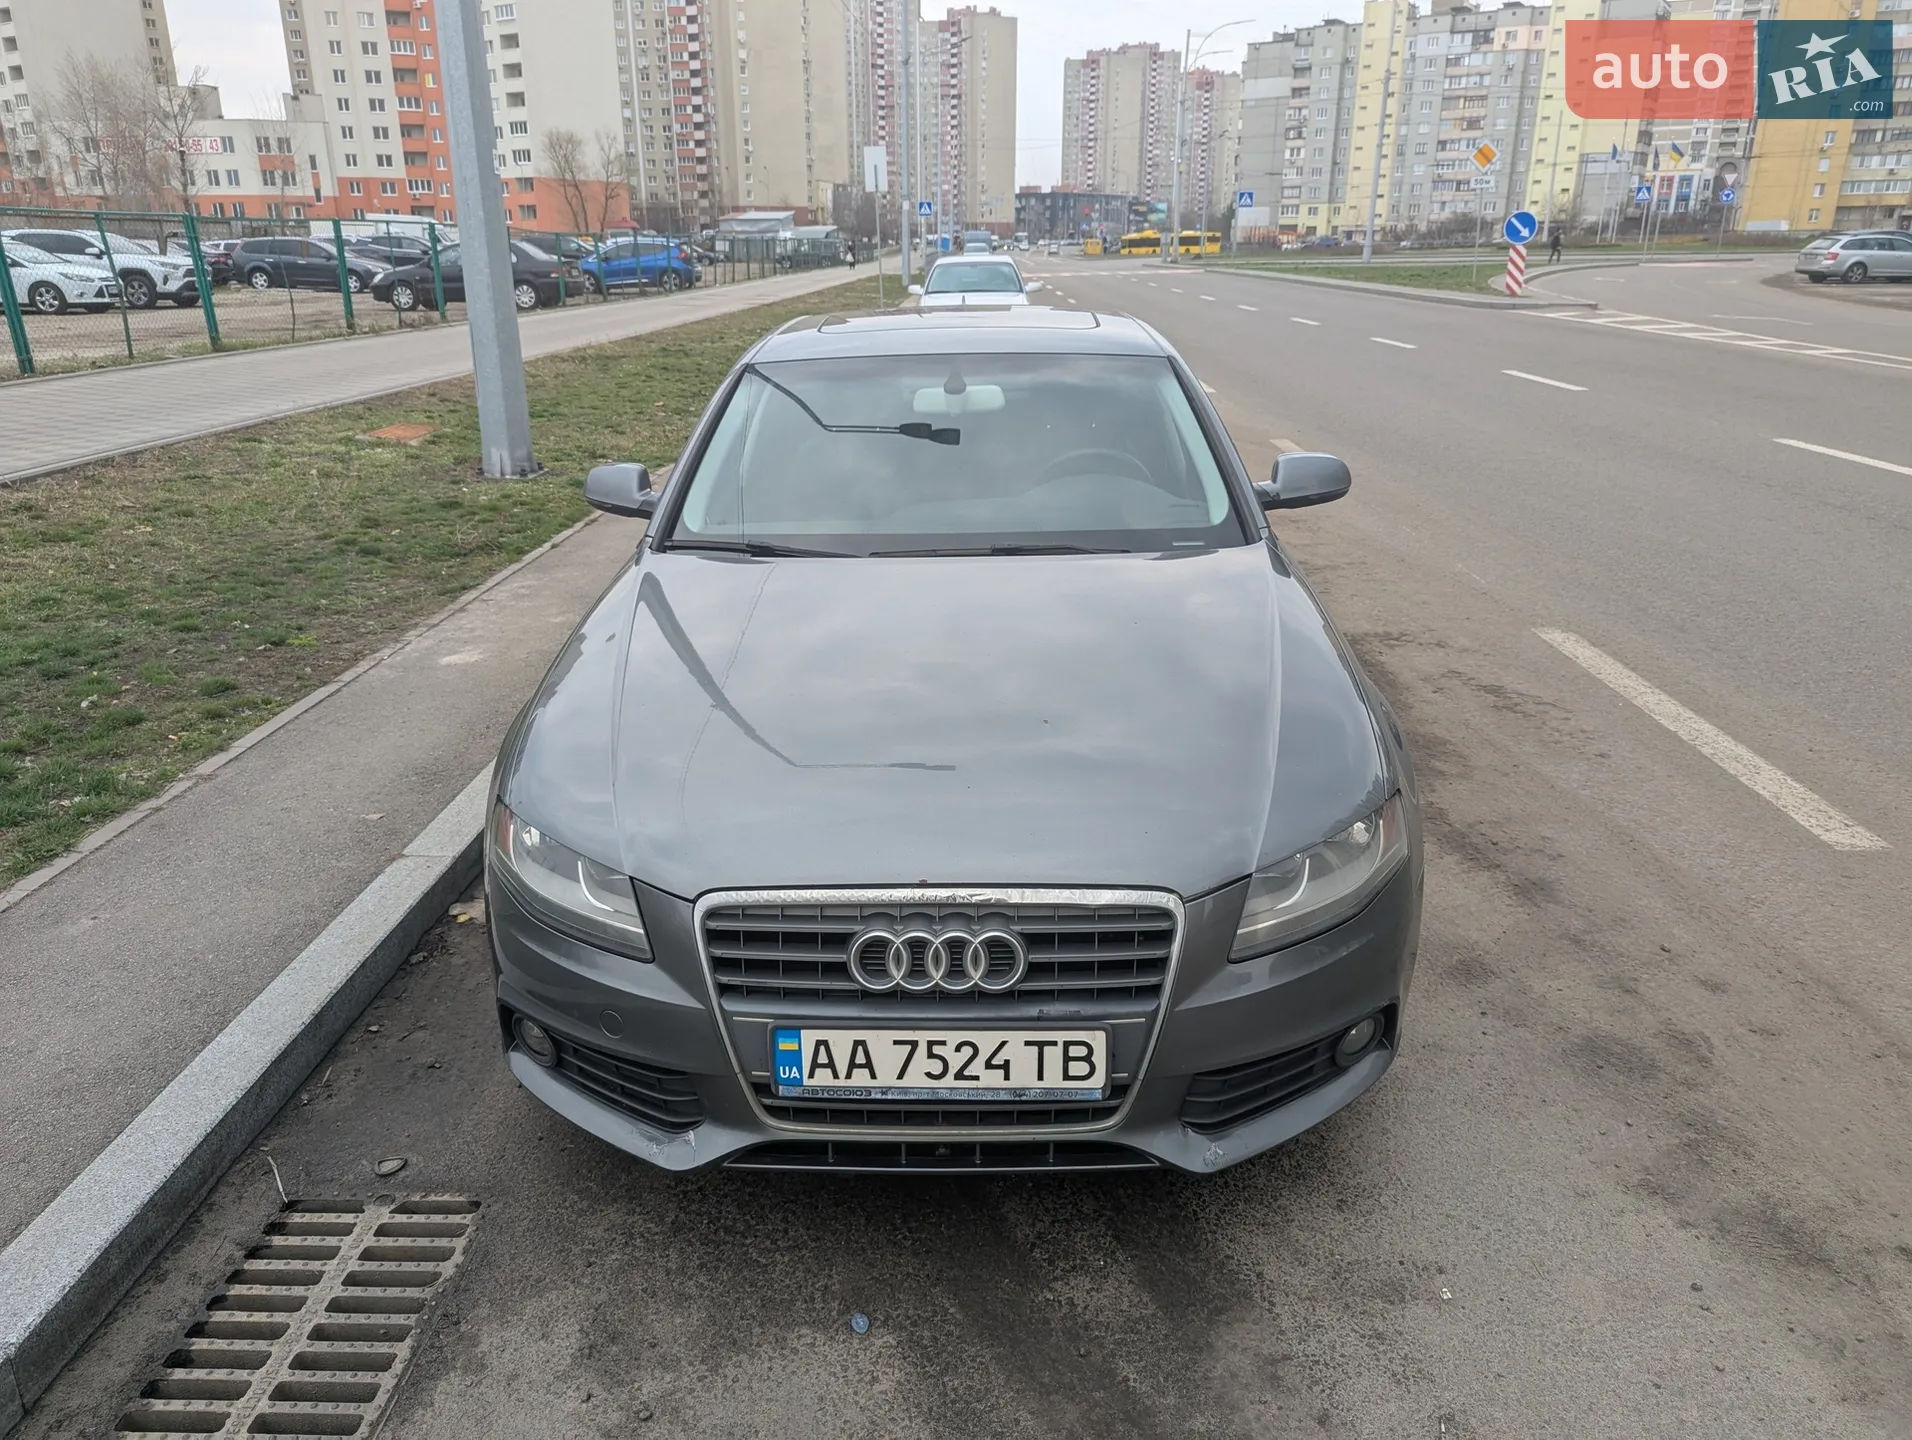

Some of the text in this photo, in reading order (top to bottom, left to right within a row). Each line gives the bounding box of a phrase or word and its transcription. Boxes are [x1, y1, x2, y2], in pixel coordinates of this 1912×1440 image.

[209, 139, 219, 152] 43
[807, 1039, 1097, 1082] AA 7524 TB
[779, 1066, 800, 1079] UA
[801, 1088, 872, 1097] АВТОСОЮЗ
[991, 1090, 1001, 1098] 28
